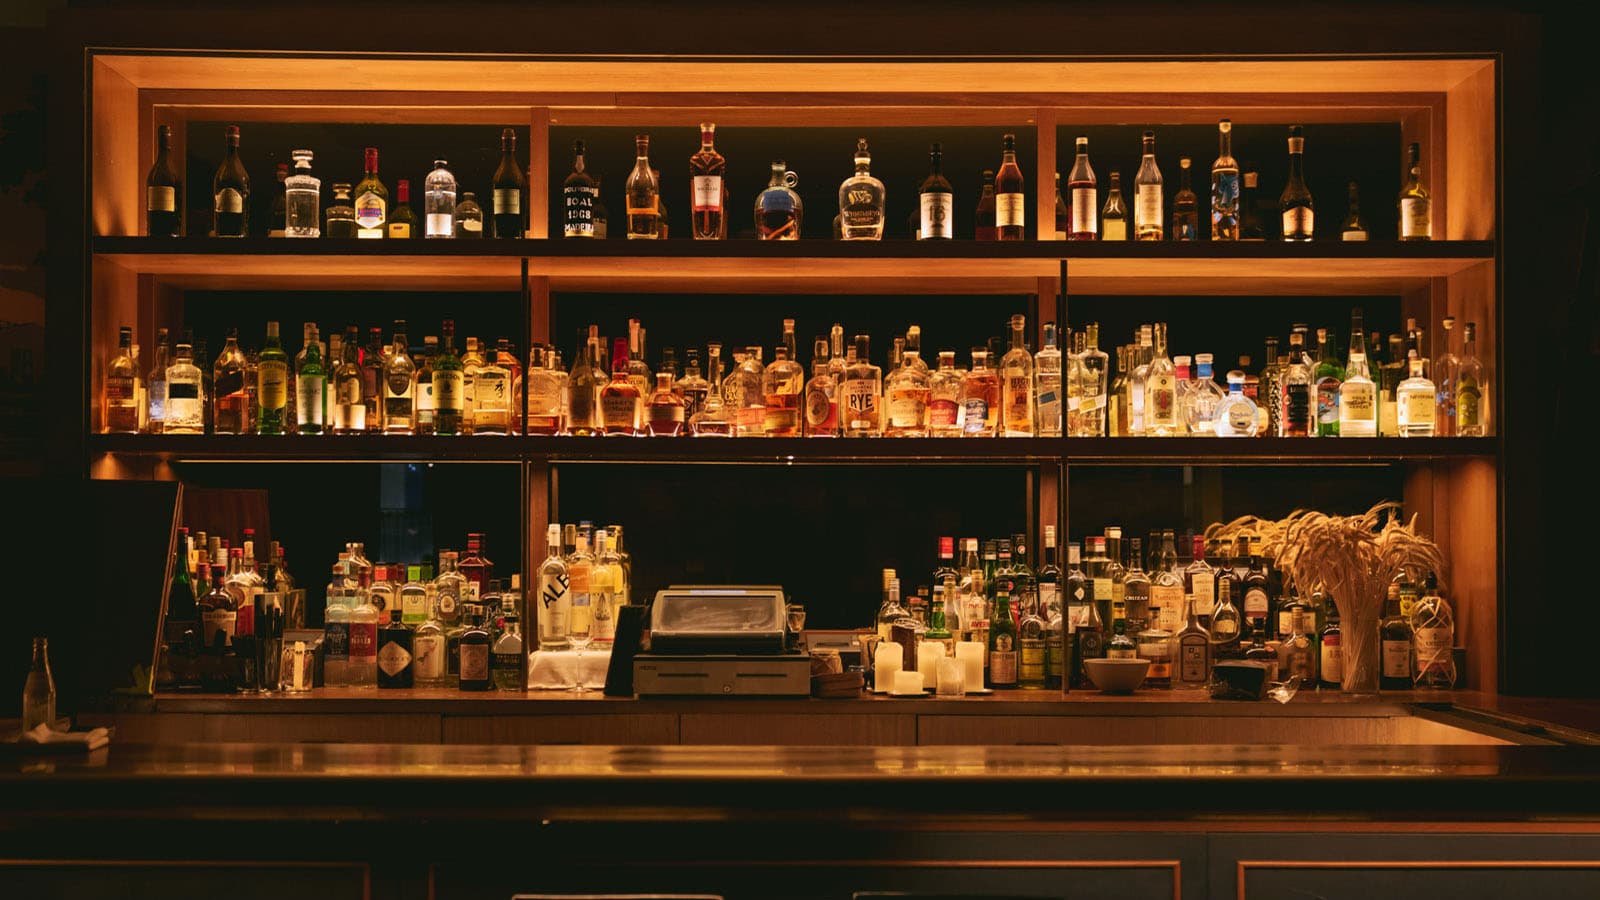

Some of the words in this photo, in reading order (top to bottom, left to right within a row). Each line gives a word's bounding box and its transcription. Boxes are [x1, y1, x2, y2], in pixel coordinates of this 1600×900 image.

[567, 197, 593, 207] BOAL
[568, 209, 591, 220] 1968
[850, 394, 873, 411] RYE
